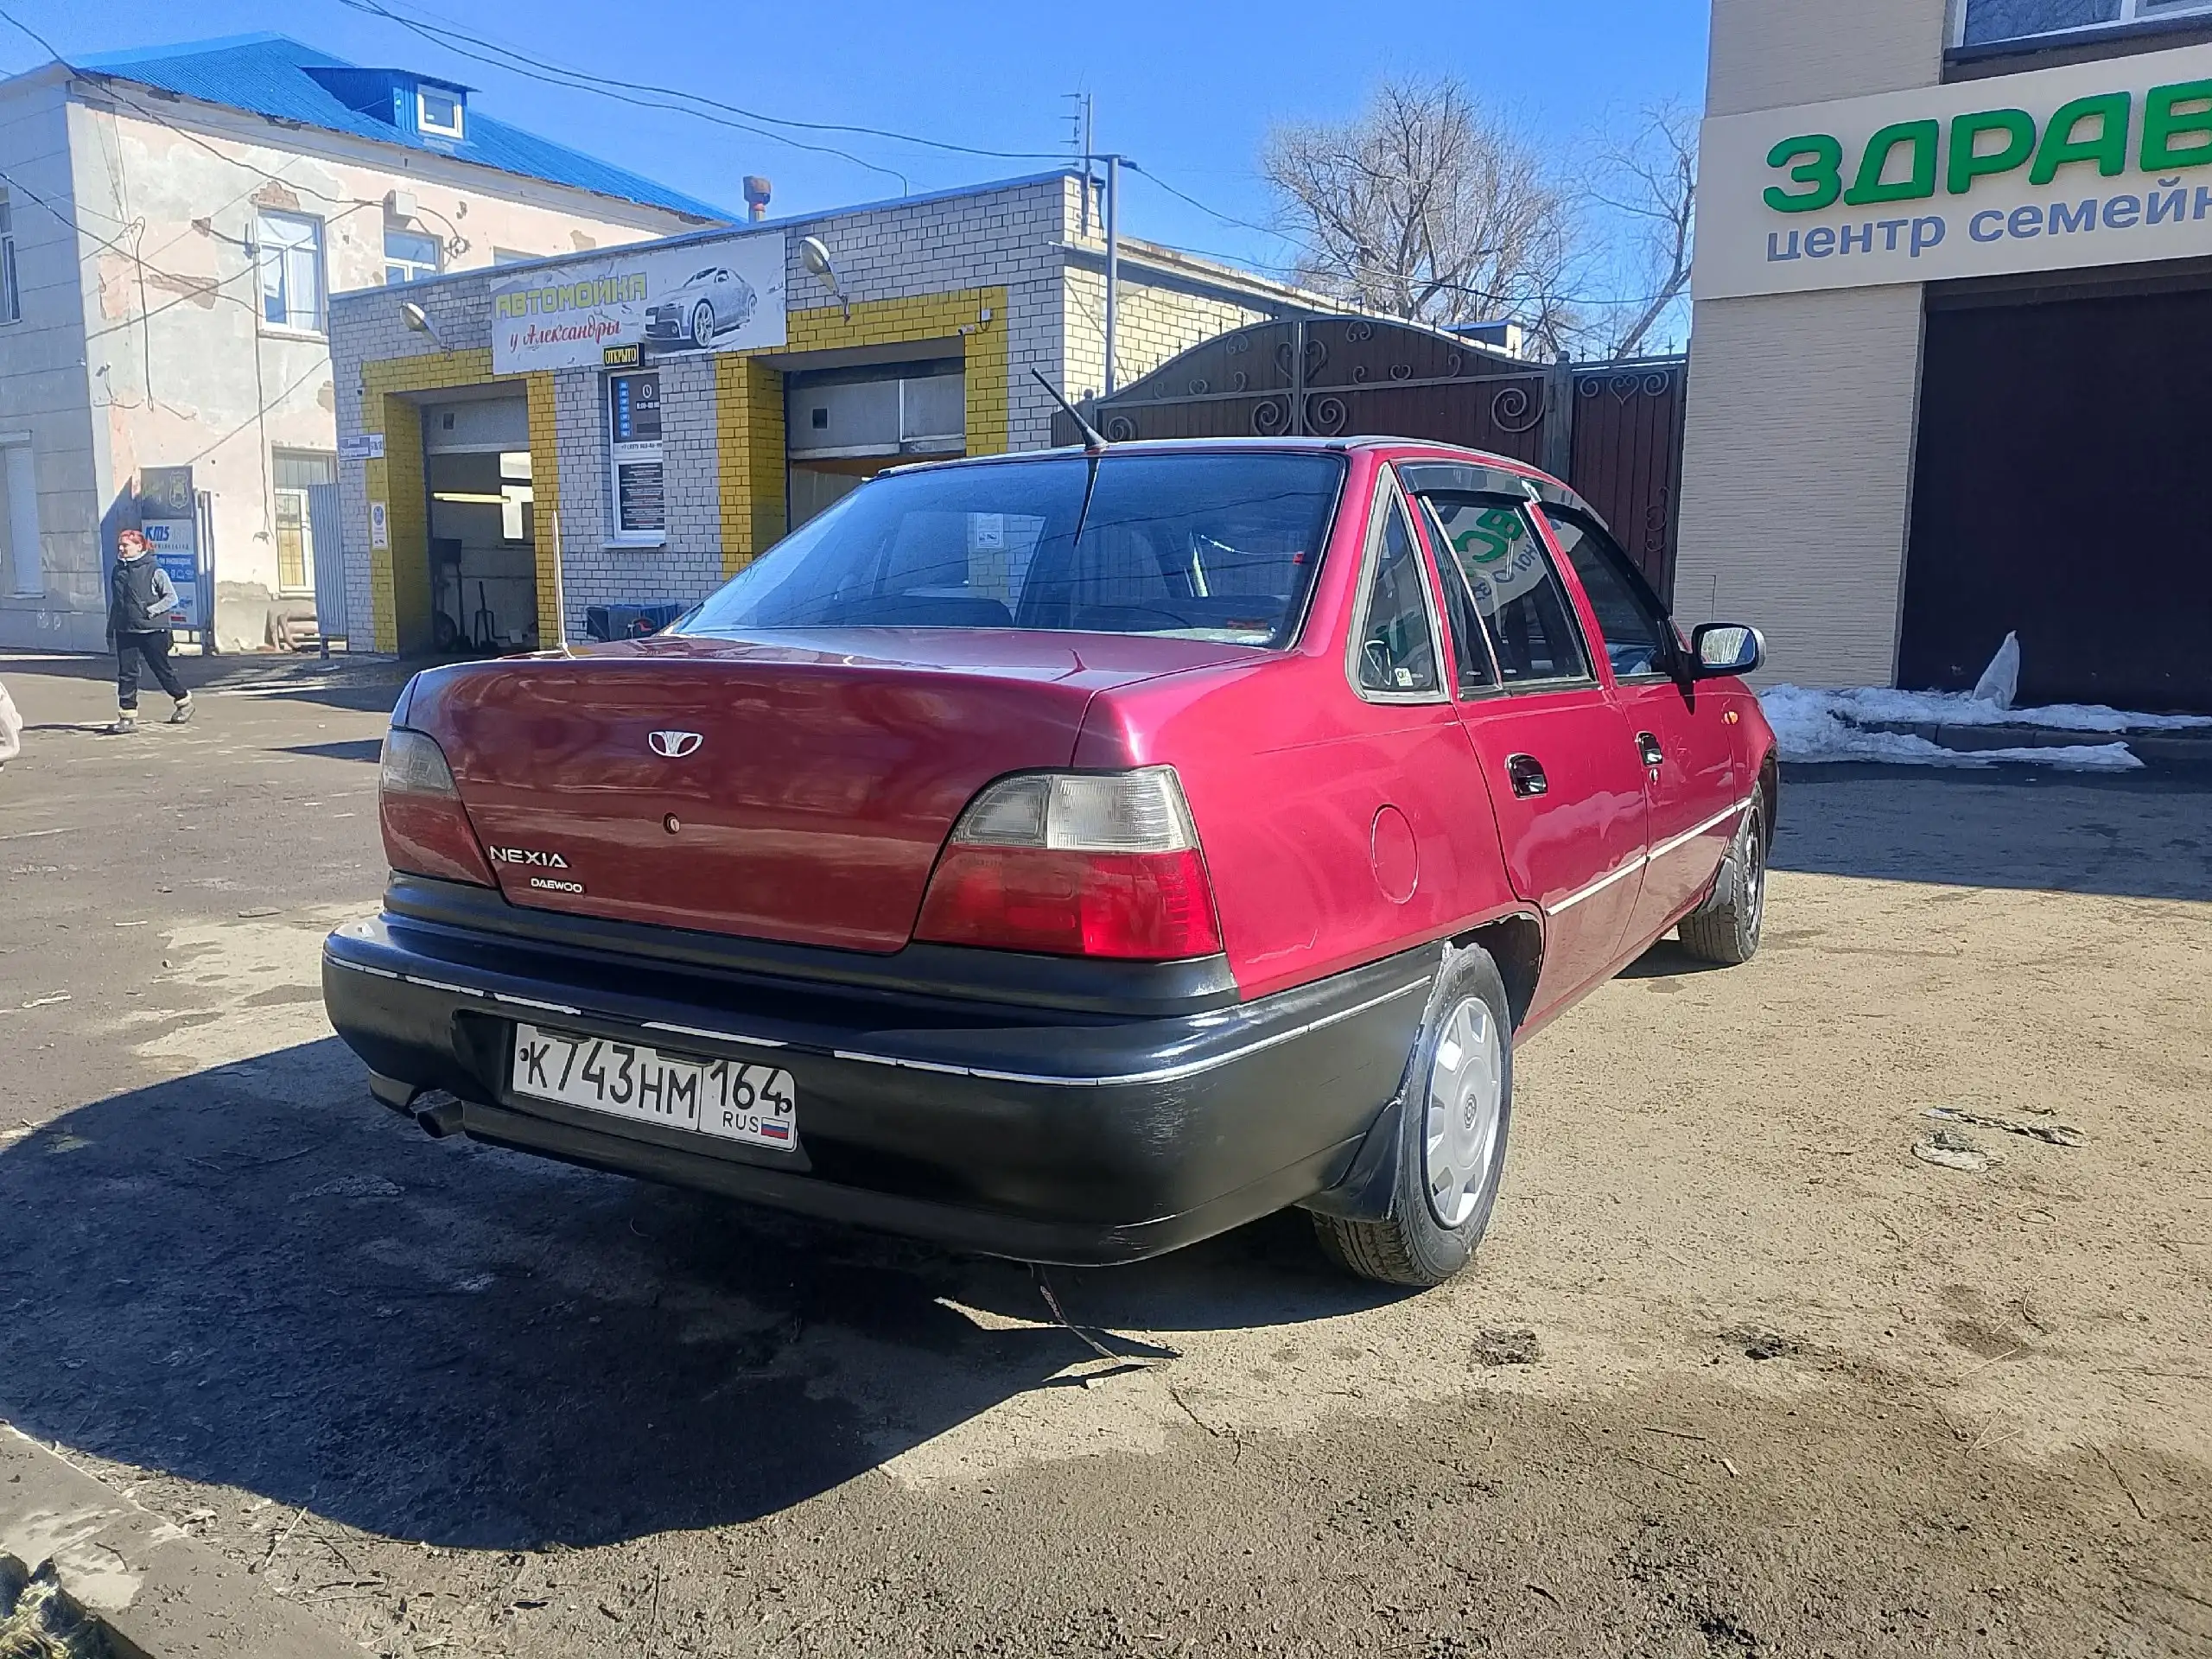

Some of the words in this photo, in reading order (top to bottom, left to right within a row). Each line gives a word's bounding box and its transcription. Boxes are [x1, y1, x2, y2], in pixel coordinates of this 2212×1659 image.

[1763, 79, 2212, 213] ЗДРАВ
[1766, 213, 1946, 262] центр
[496, 272, 647, 320] АВТОМОЙКА
[523, 315, 622, 345] Александры
[605, 347, 637, 365] ОТКРЫТО
[489, 845, 569, 868] NEXIA
[530, 877, 583, 893] DAEWOO
[710, 1061, 783, 1116] 164
[722, 1110, 759, 1133] RUS
